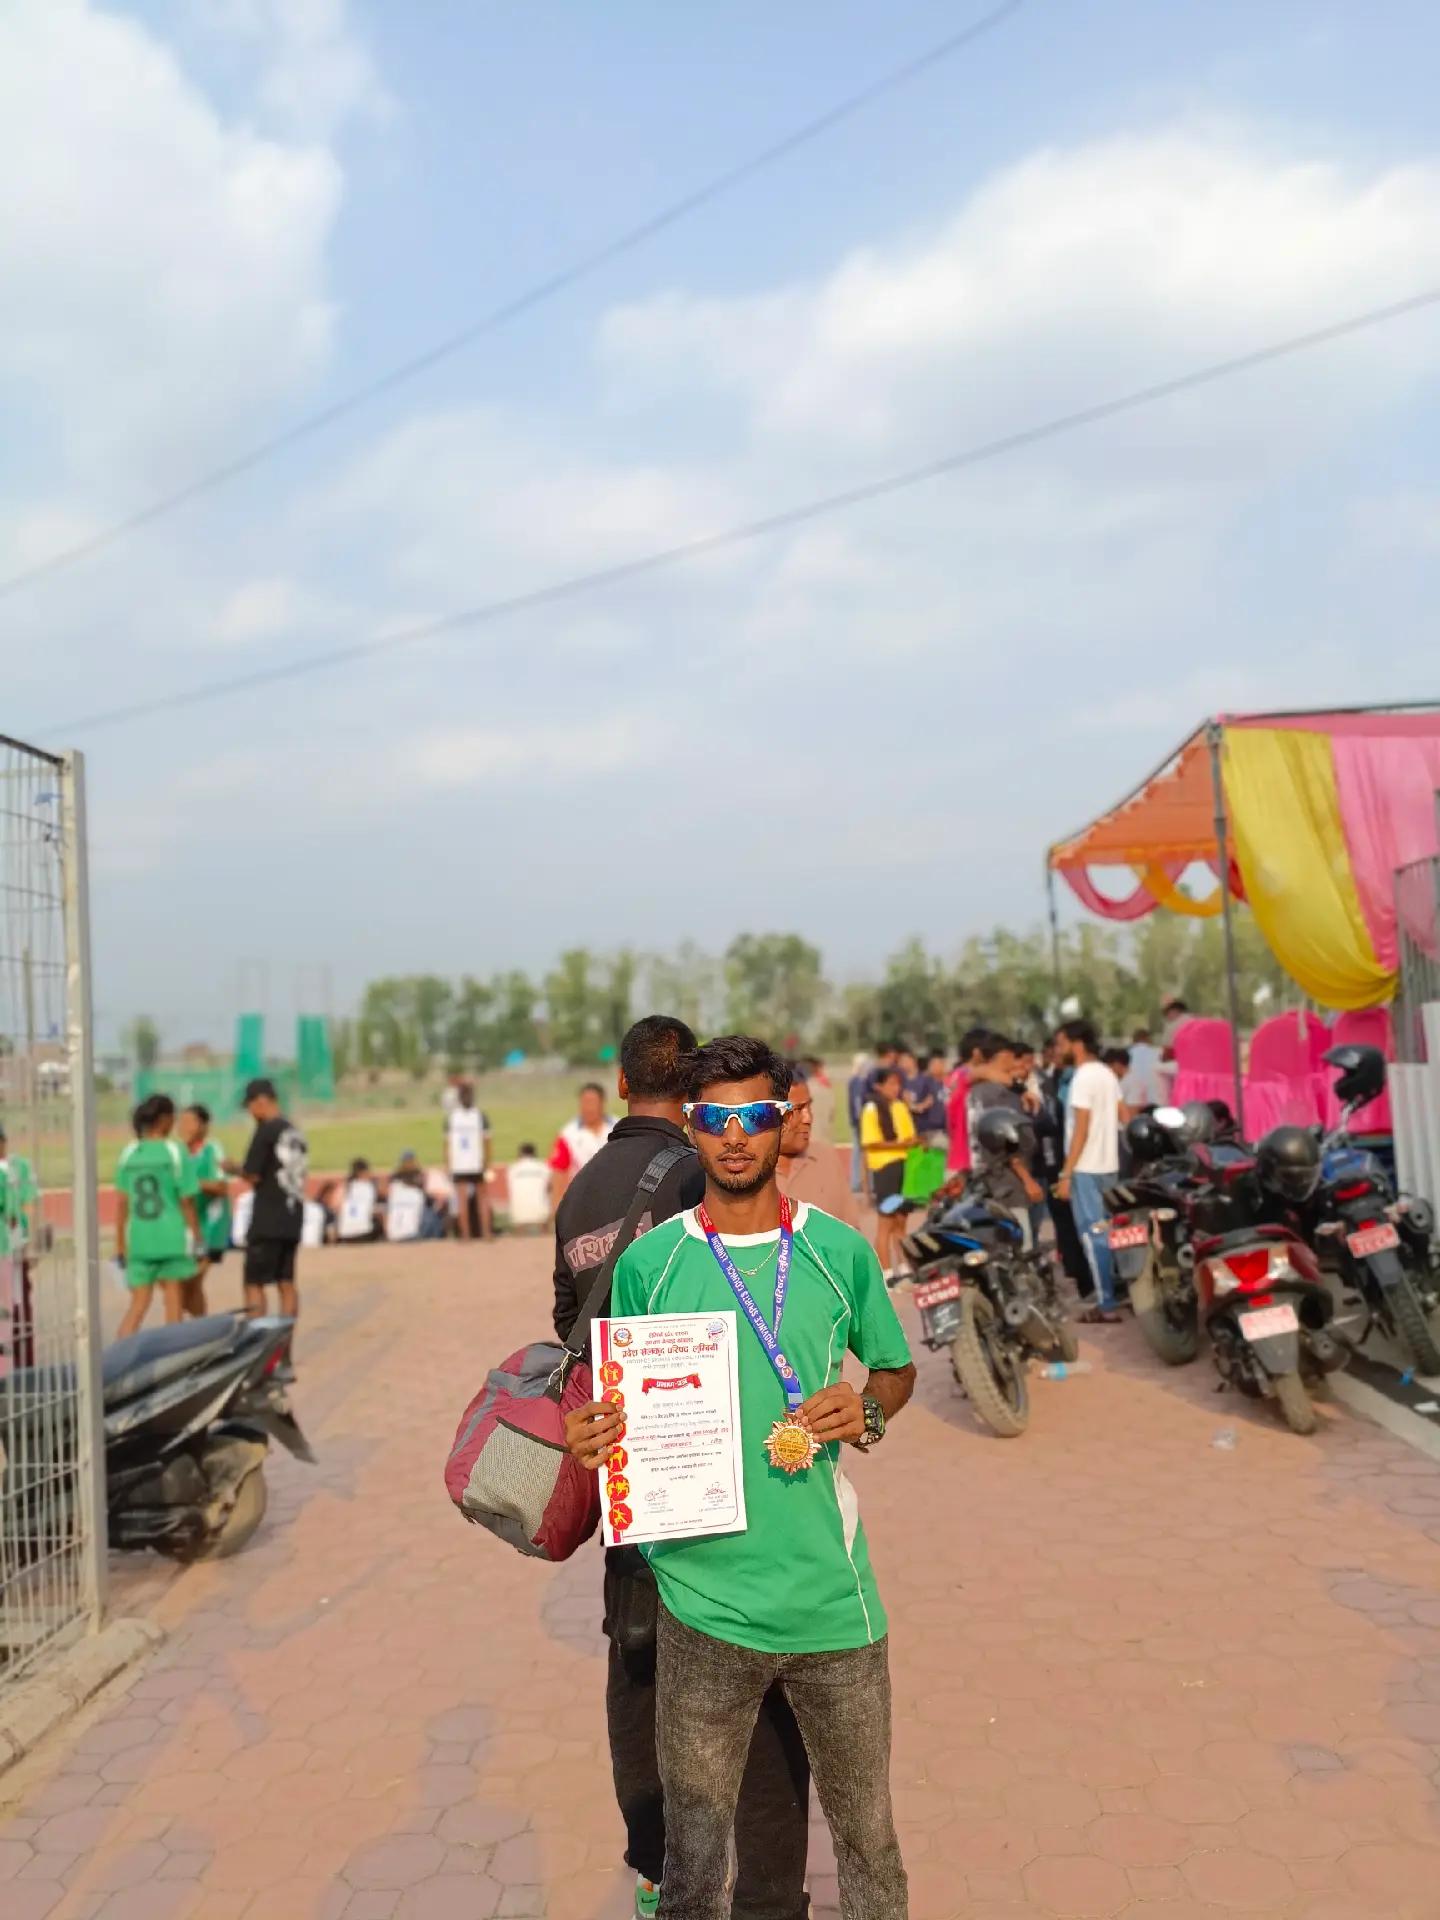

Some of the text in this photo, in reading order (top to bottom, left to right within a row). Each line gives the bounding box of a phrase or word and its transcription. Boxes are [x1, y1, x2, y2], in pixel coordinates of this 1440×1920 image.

[134, 1174, 164, 1220] 8
[739, 1289, 759, 1317] SPORTS
[753, 1315, 778, 1350] PROVINCE
